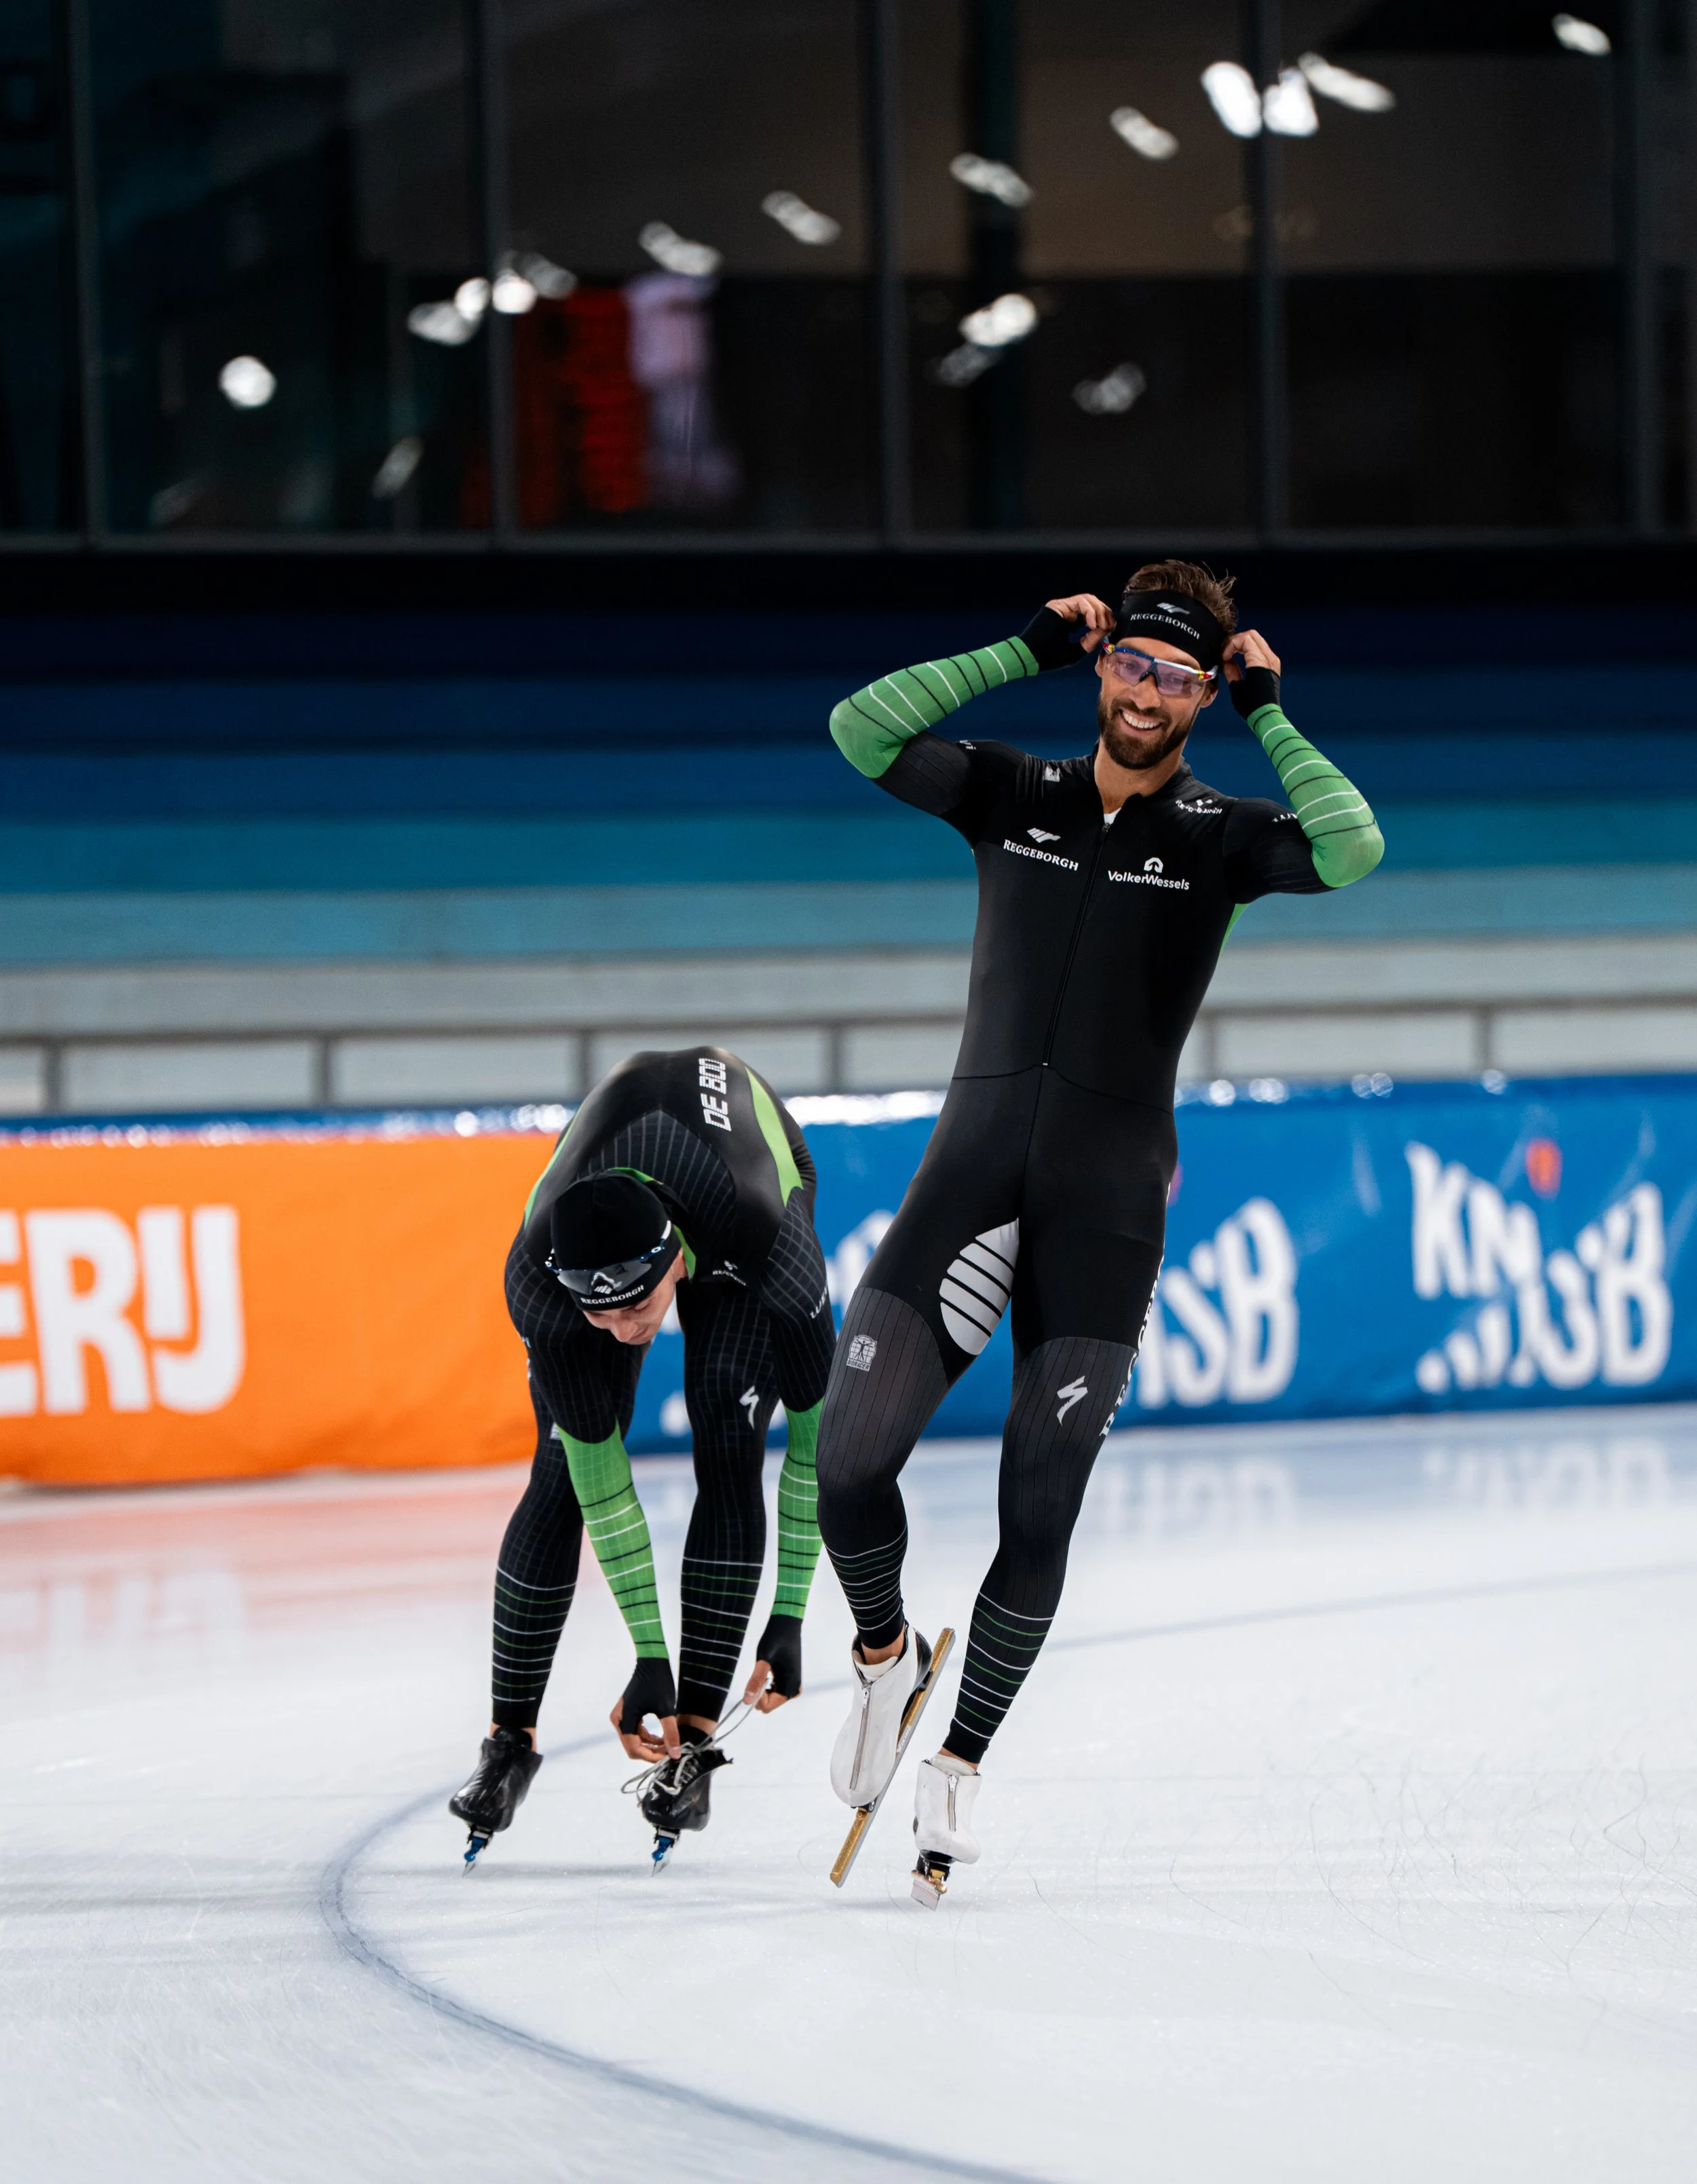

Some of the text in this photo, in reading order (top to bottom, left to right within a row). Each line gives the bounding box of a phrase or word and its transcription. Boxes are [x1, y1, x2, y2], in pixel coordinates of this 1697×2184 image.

[1130, 613, 1200, 639] REGGEBORGH
[1003, 839, 1079, 871] REGGEBORGH
[1108, 870, 1189, 890] VolkerWessels
[701, 1093, 732, 1132] DE
[580, 1285, 644, 1304] REGGEBORGH
